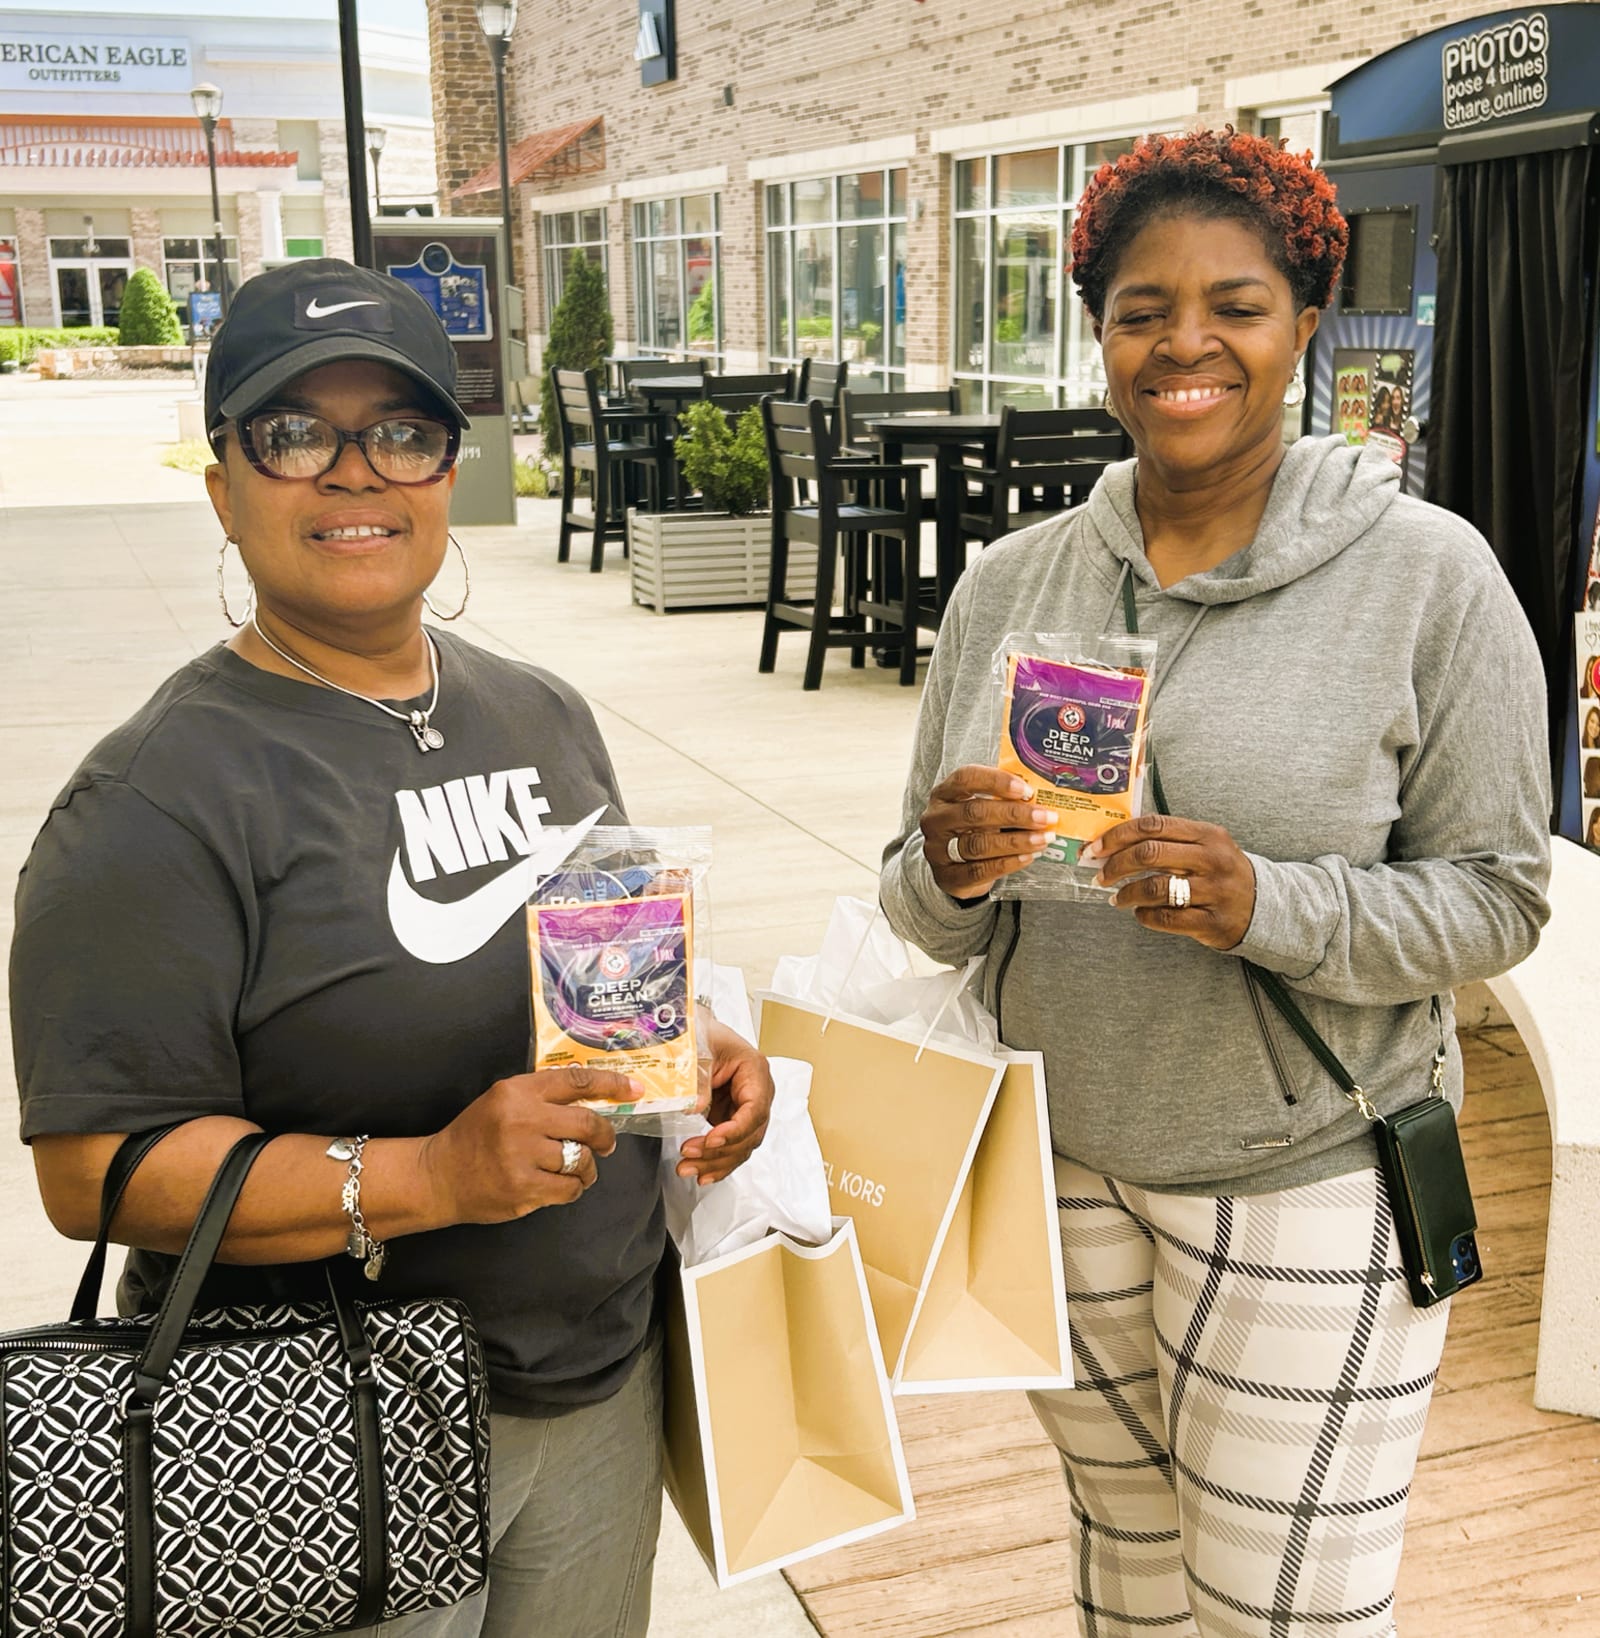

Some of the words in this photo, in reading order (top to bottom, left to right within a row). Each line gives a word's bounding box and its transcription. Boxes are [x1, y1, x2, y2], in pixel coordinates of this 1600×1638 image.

[107, 46, 187, 67] EAGLE
[1446, 20, 1546, 79] PHOTOS
[28, 68, 121, 82] OUTFITTERS
[1447, 76, 1483, 105] pose
[1486, 67, 1497, 87] 4
[1499, 57, 1544, 83] times
[1447, 98, 1491, 124] share
[1494, 81, 1543, 112] online
[1042, 738, 1094, 757] CLEAN
[1049, 729, 1090, 745] DEEP
[395, 767, 552, 883] NIKE
[593, 980, 642, 995] DEEP
[588, 990, 648, 1007] CLEAN
[839, 1169, 886, 1207] KORS
